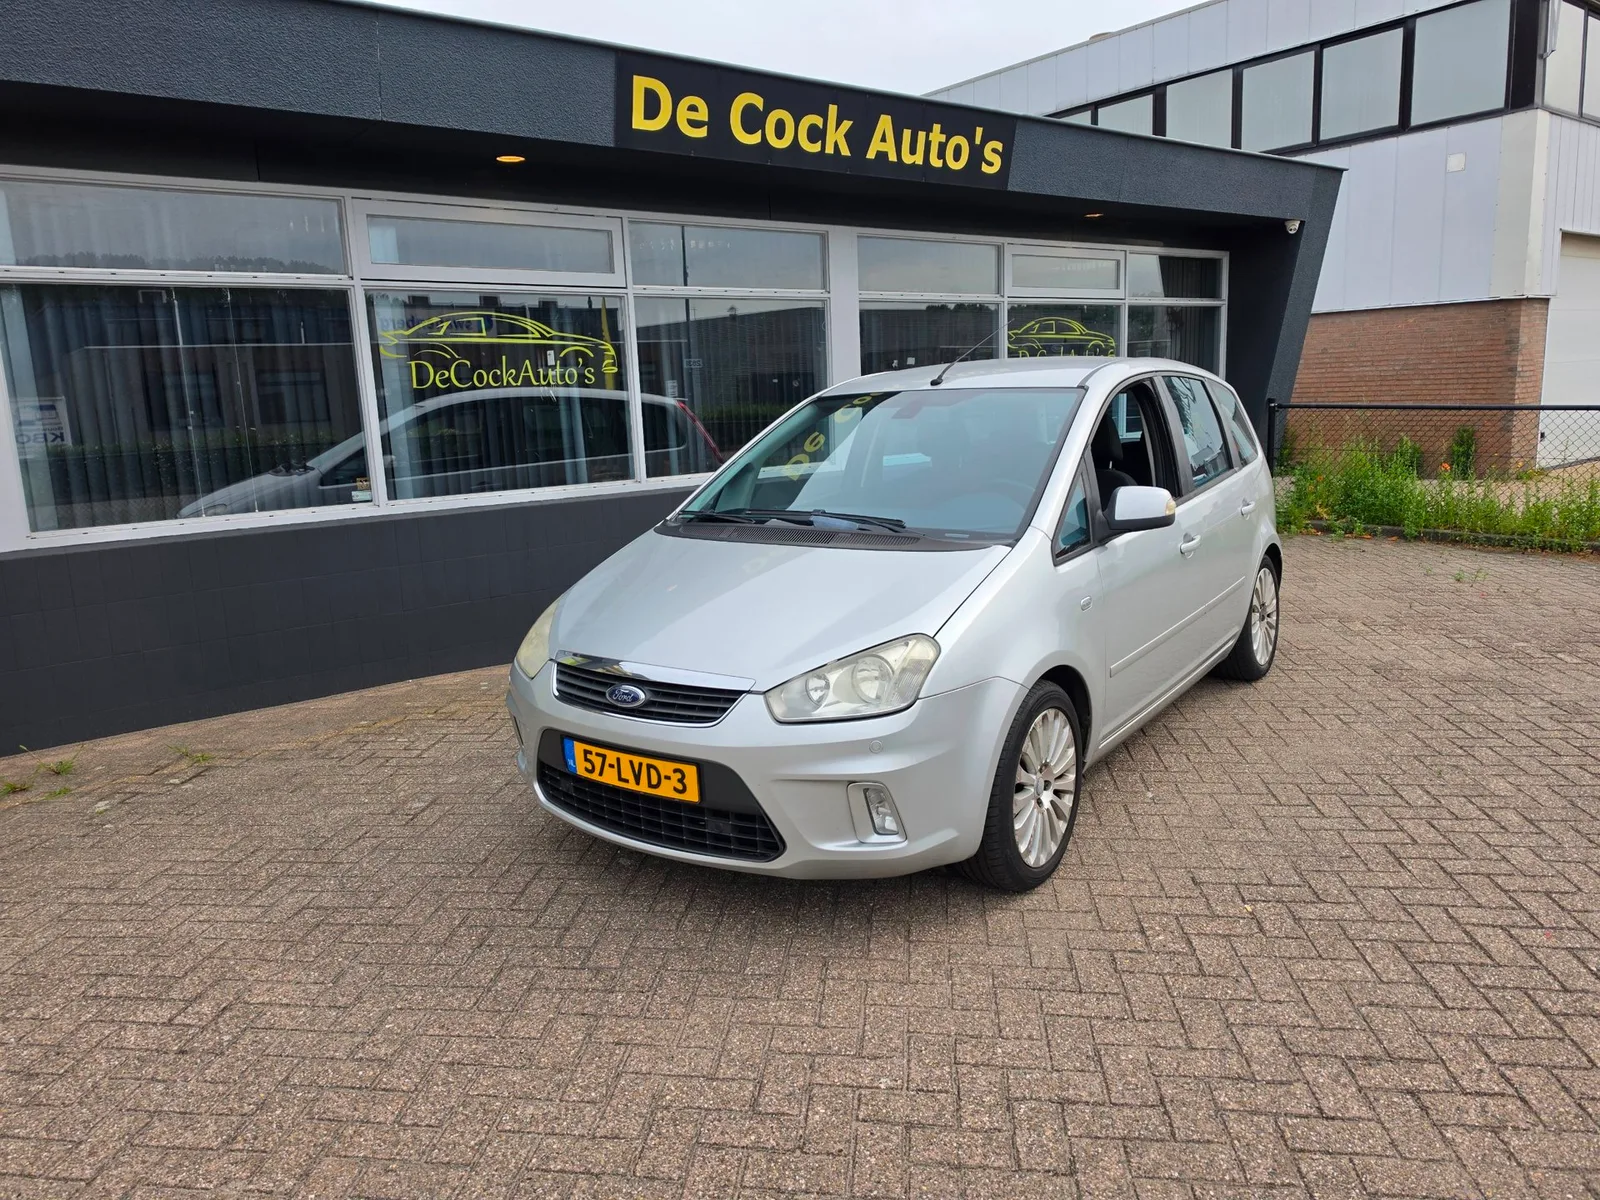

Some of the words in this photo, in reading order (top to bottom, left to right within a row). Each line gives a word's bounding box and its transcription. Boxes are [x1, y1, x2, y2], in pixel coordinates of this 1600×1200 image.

[631, 74, 709, 138] De
[730, 92, 853, 157] Cock
[865, 114, 1003, 174] Auto's
[406, 355, 596, 390] DeCockAuto's
[583, 748, 688, 795] 57-LVD-3
